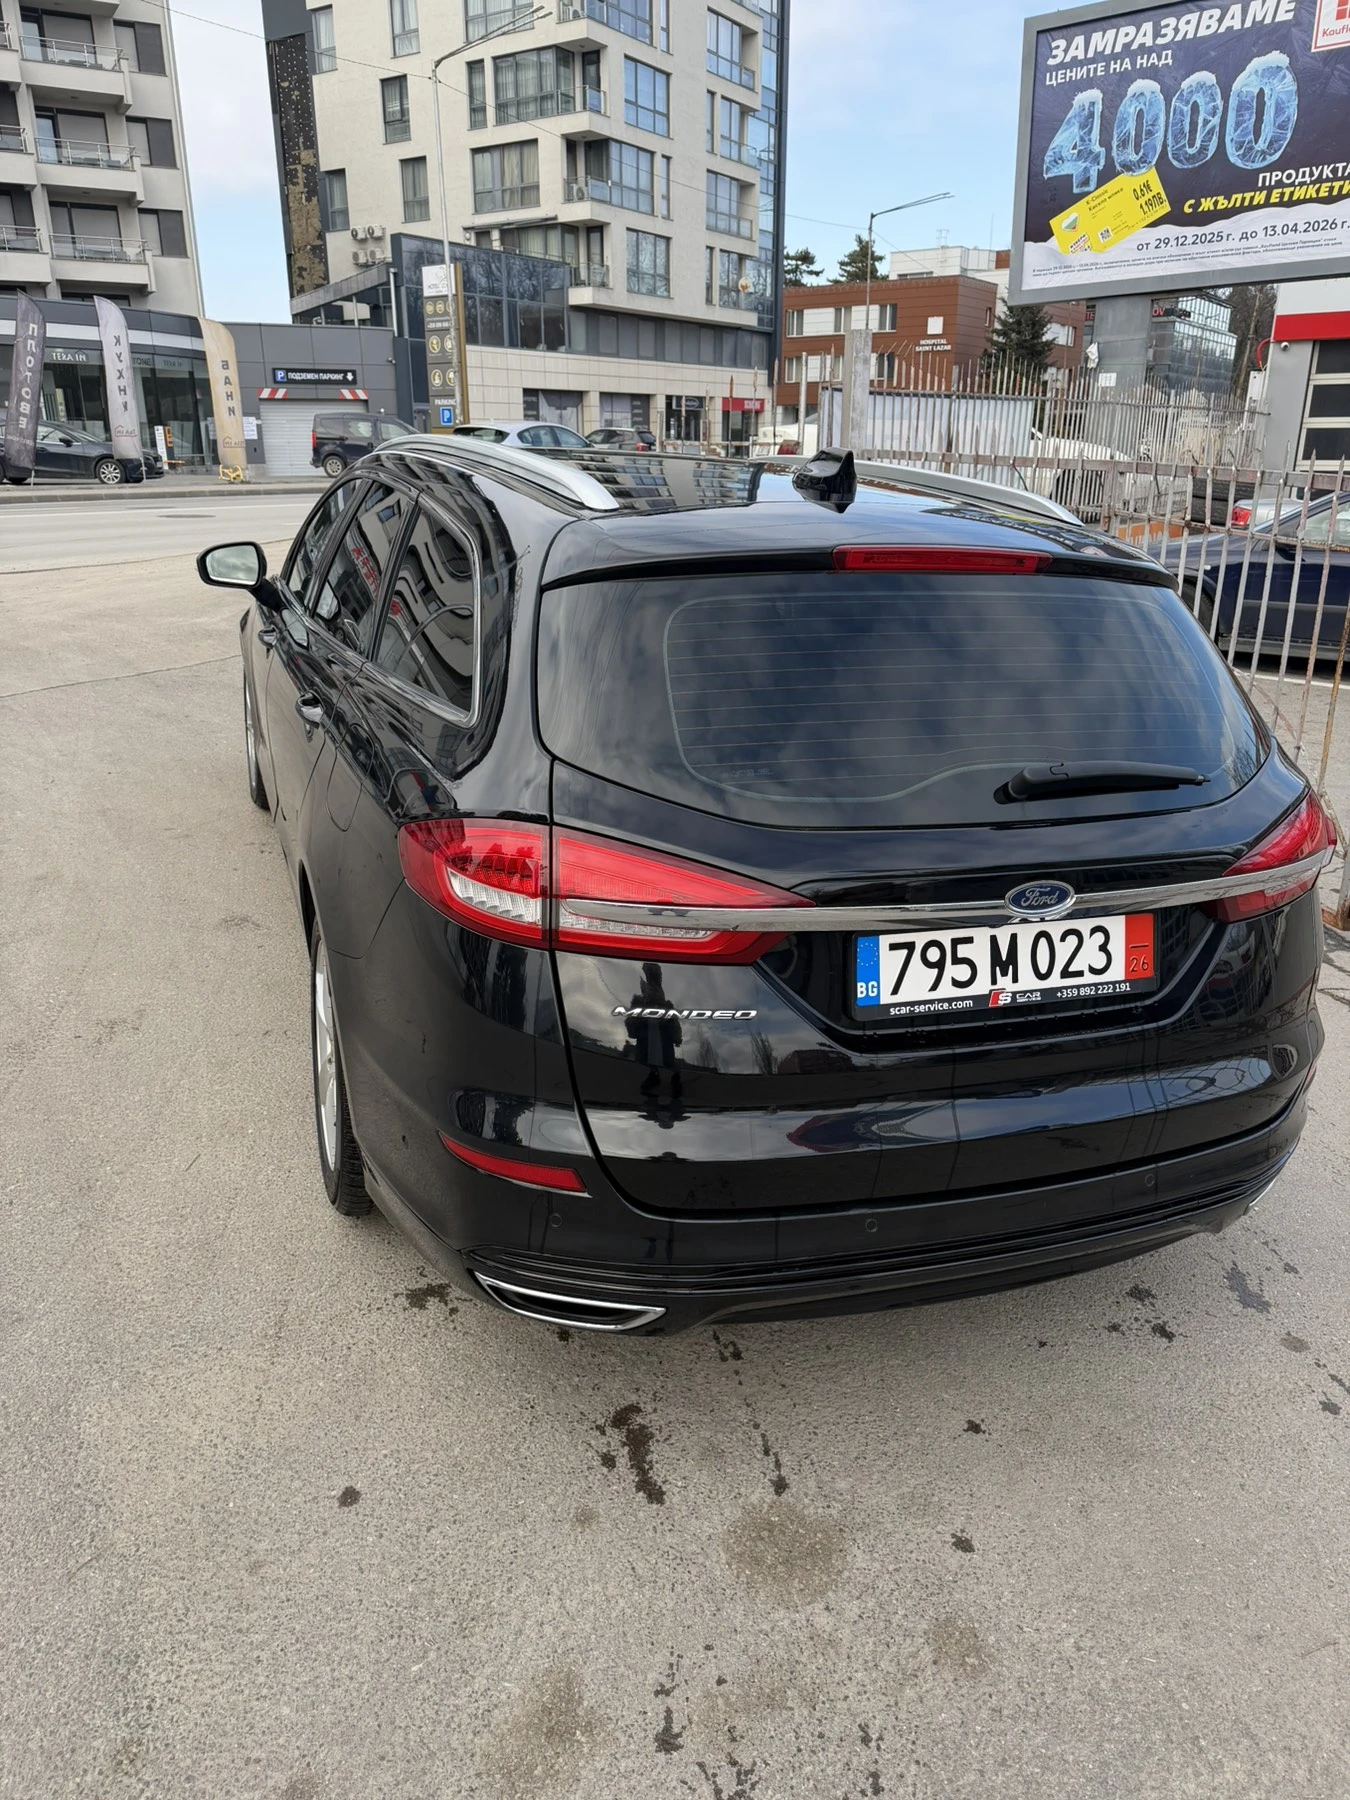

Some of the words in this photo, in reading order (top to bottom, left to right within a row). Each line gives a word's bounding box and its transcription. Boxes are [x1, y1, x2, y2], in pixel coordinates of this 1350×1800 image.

[1047, 0, 1296, 66] ЗАМРАЗЯВАМЕ
[1322, 24, 1350, 37] Kaufl
[1045, 62, 1106, 87] ЦЕНИТЕ
[1109, 58, 1132, 74] НА
[1136, 50, 1173, 68] НАД
[1043, 50, 1298, 194] 4000
[1197, 191, 1268, 213] ЖЪЛТИ
[1136, 242, 1151, 252] от
[1154, 231, 1224, 249] 29.12.2025
[1226, 232, 1235, 242] г.
[1239, 230, 1258, 242] до
[1262, 218, 1338, 238] 13.04.2026
[1341, 220, 1350, 229] г.
[288, 372, 319, 380] ПОДЗЕМЕН
[1020, 887, 1059, 907] Ford
[888, 936, 978, 996] 795
[990, 932, 1018, 986] M
[1030, 925, 1113, 981] 023
[1129, 954, 1149, 974] 26
[857, 981, 878, 998] BG
[1056, 986, 1078, 999] +359
[1079, 985, 1096, 997] 892
[1098, 984, 1114, 995] 222
[1115, 982, 1131, 993] 191
[611, 1006, 758, 1020] MONDEO
[889, 998, 974, 1016] scar-service.com
